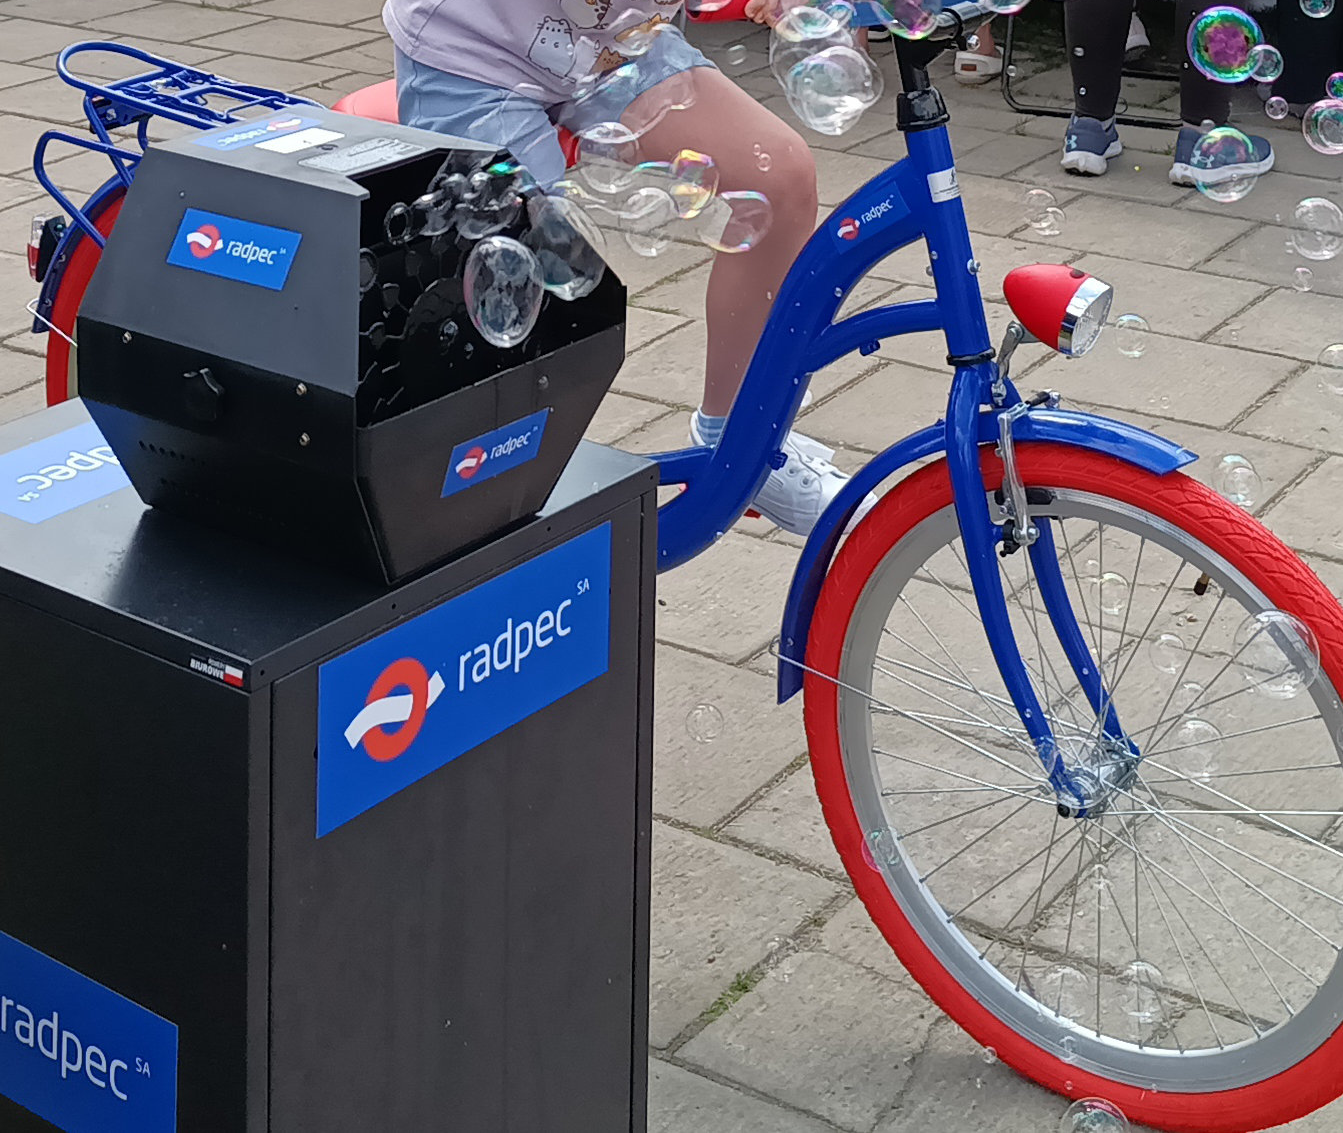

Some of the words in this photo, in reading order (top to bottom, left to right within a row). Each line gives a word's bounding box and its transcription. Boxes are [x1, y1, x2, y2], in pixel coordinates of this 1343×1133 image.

[861, 198, 894, 224] radpec
[226, 240, 278, 265] radpec
[490, 432, 531, 460] radpec
[16, 445, 121, 491] dpec
[458, 598, 572, 692] radpec
[576, 577, 591, 596] SA
[1, 995, 128, 1101] radpec
[135, 1057, 151, 1079] SA
